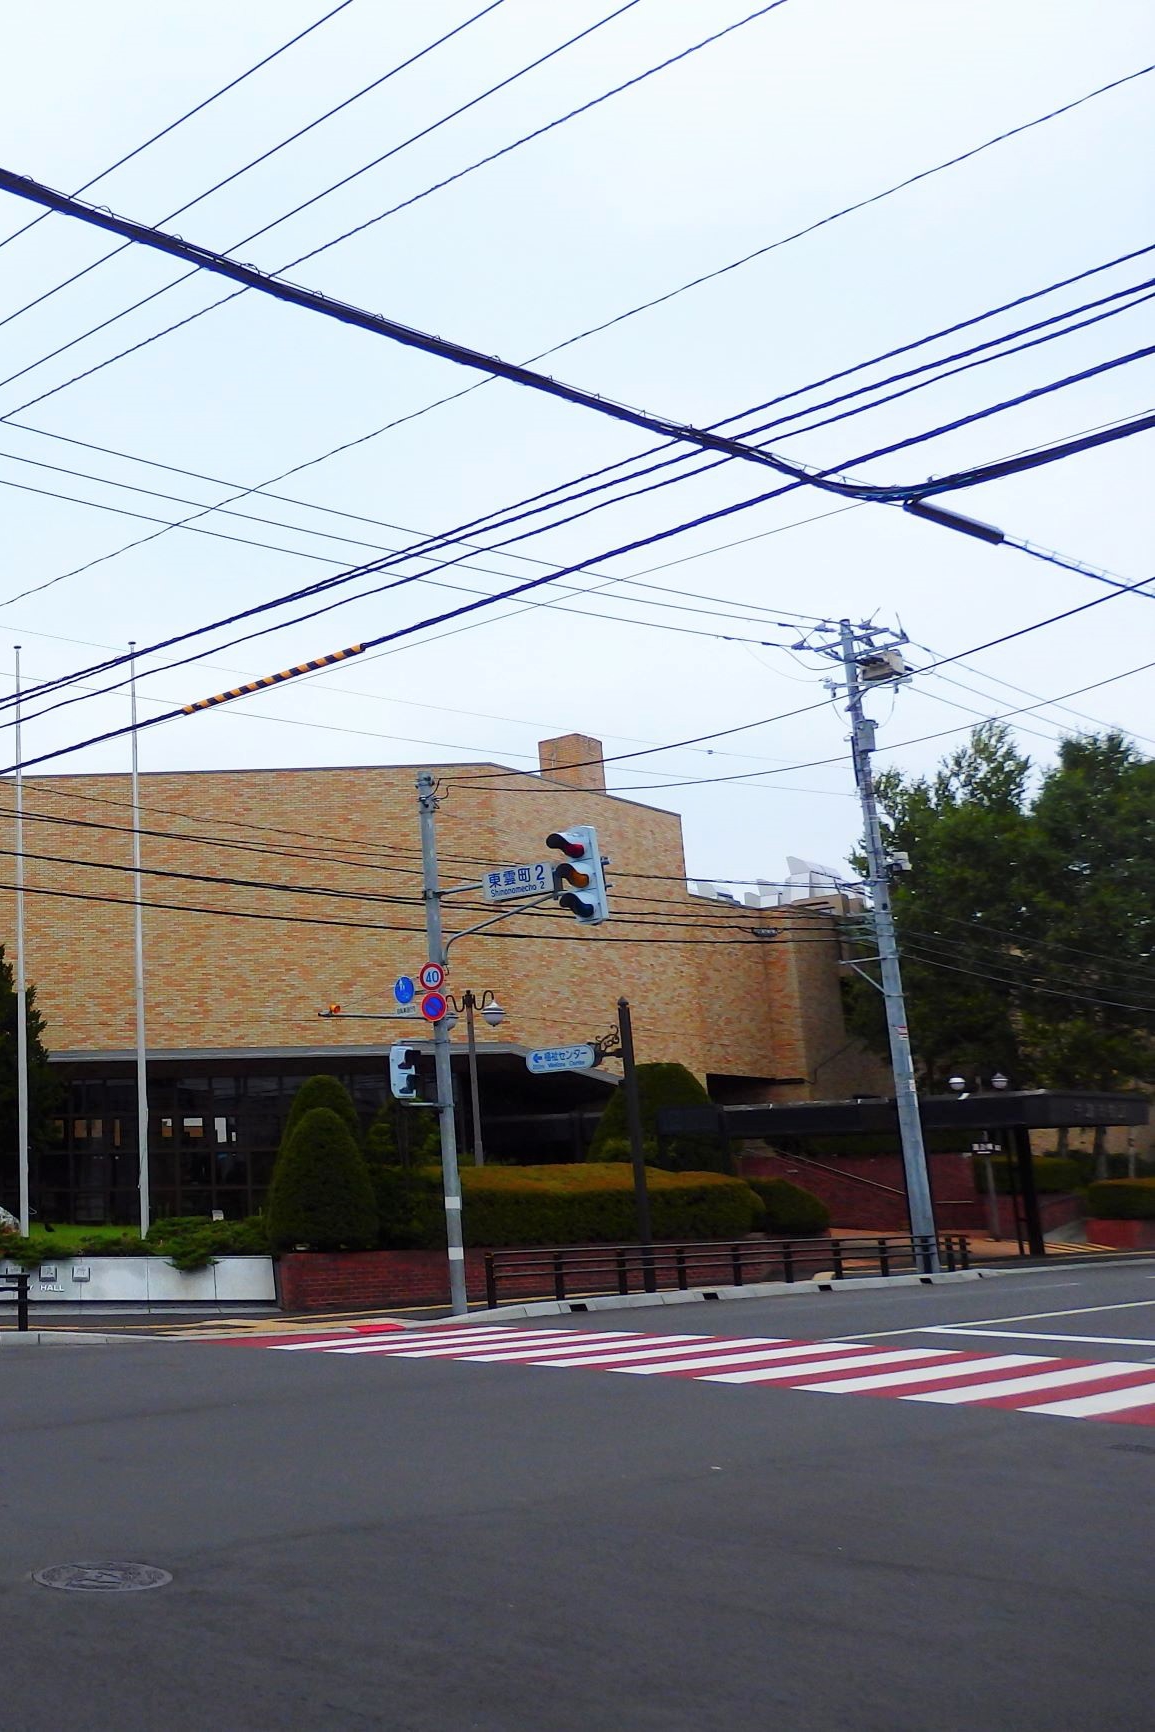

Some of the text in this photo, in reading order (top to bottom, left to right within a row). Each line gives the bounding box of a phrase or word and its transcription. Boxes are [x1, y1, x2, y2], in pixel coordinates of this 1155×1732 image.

[491, 881, 545, 897] Shinonomecho 2
[426, 971, 439, 983] 40
